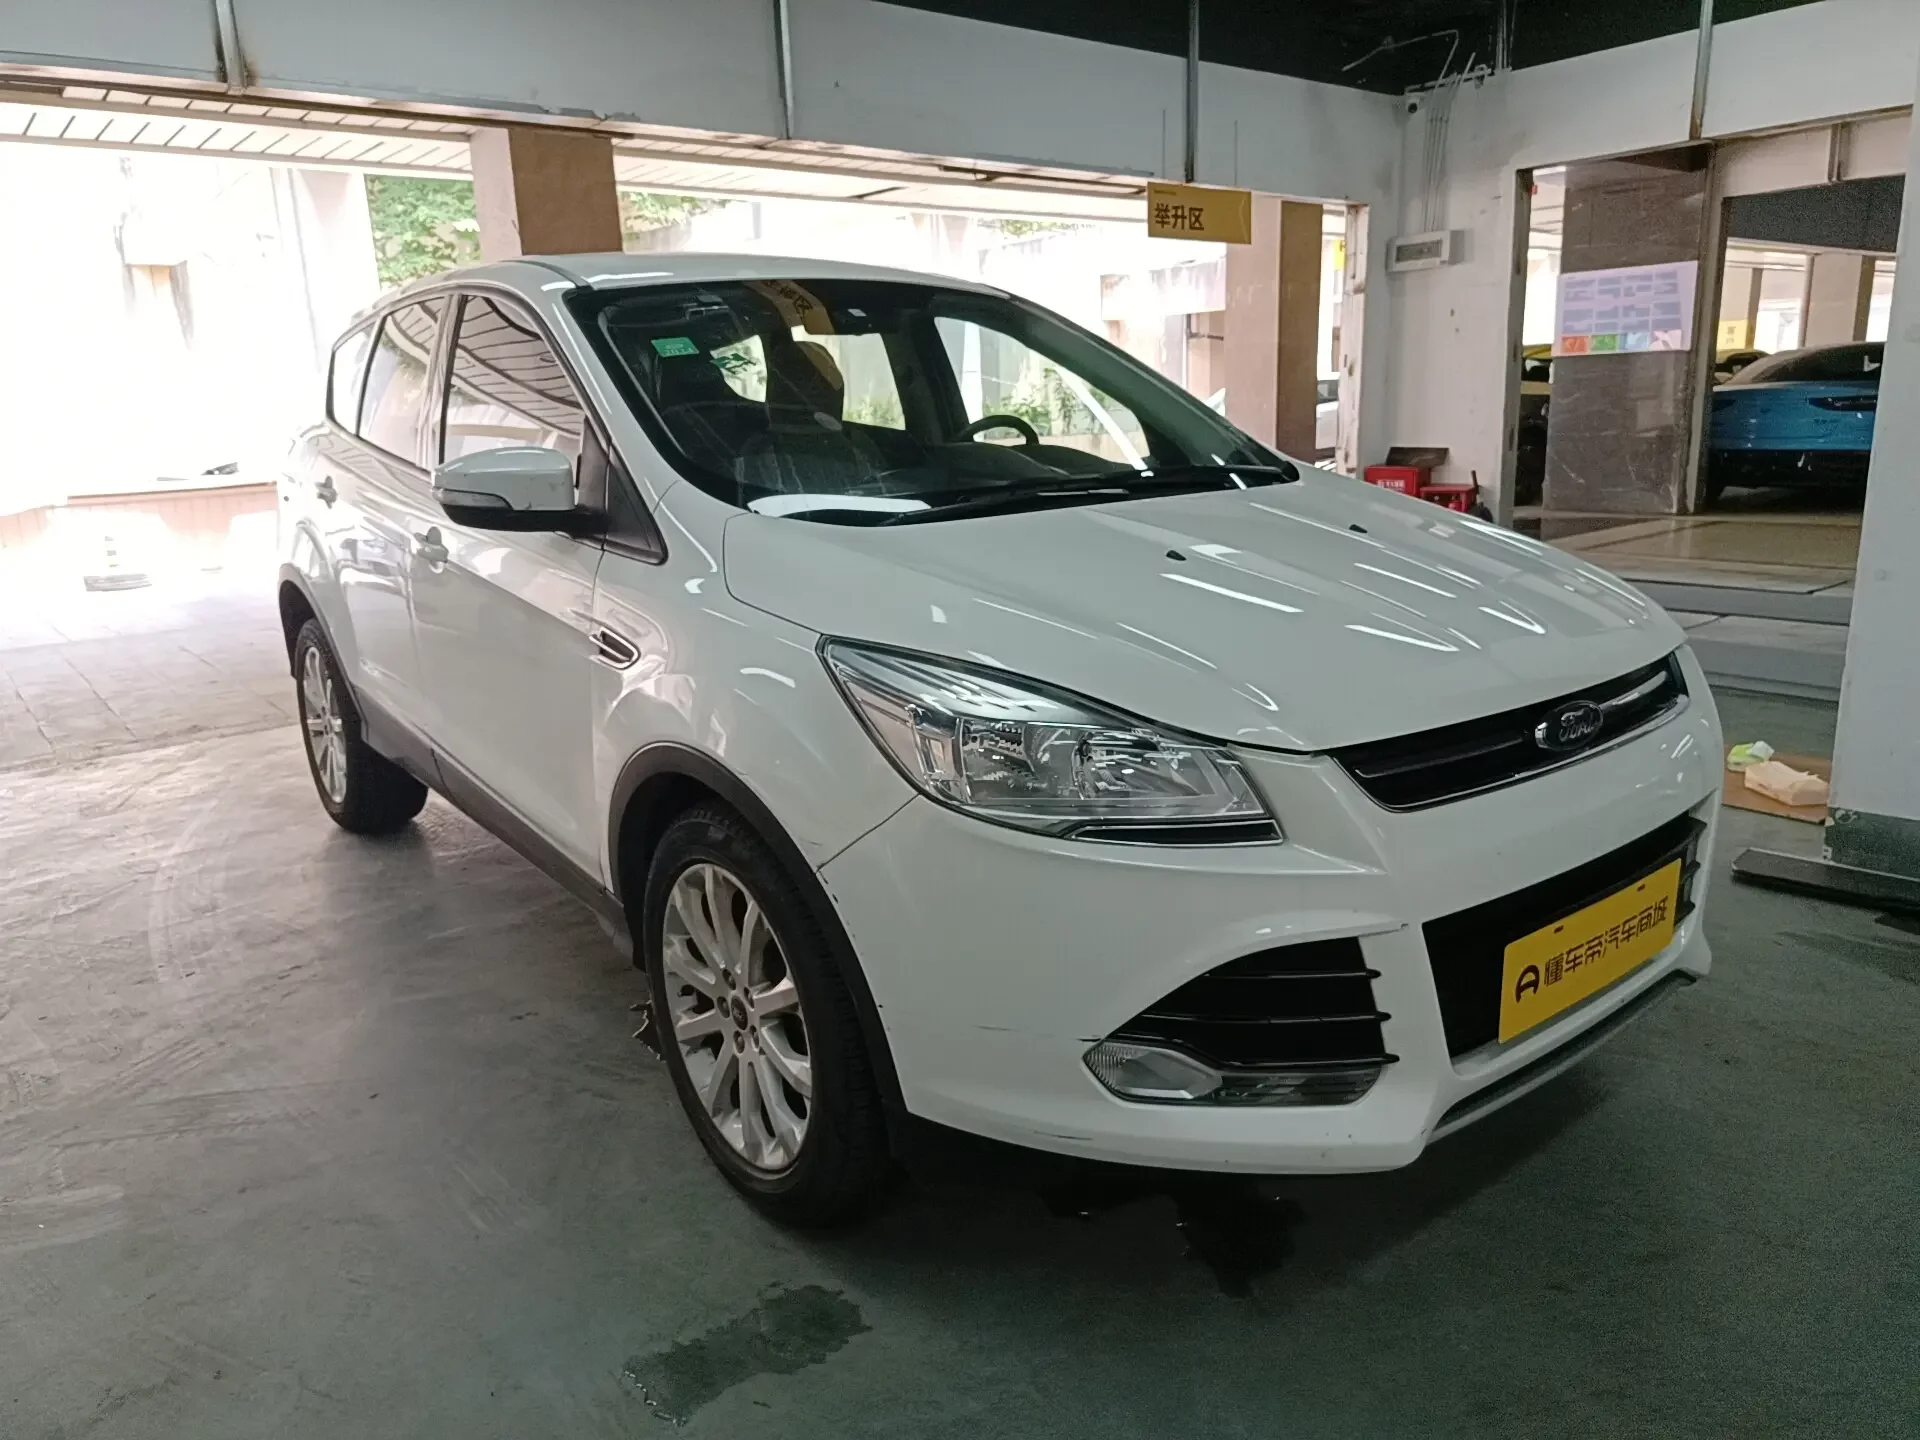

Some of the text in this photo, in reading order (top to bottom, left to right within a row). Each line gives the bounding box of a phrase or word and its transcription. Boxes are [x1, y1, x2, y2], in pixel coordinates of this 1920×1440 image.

[1154, 202, 1204, 231] 举升区
[1559, 708, 1597, 742] Ford
[1543, 896, 1669, 987] 懂车帝汽车商城
